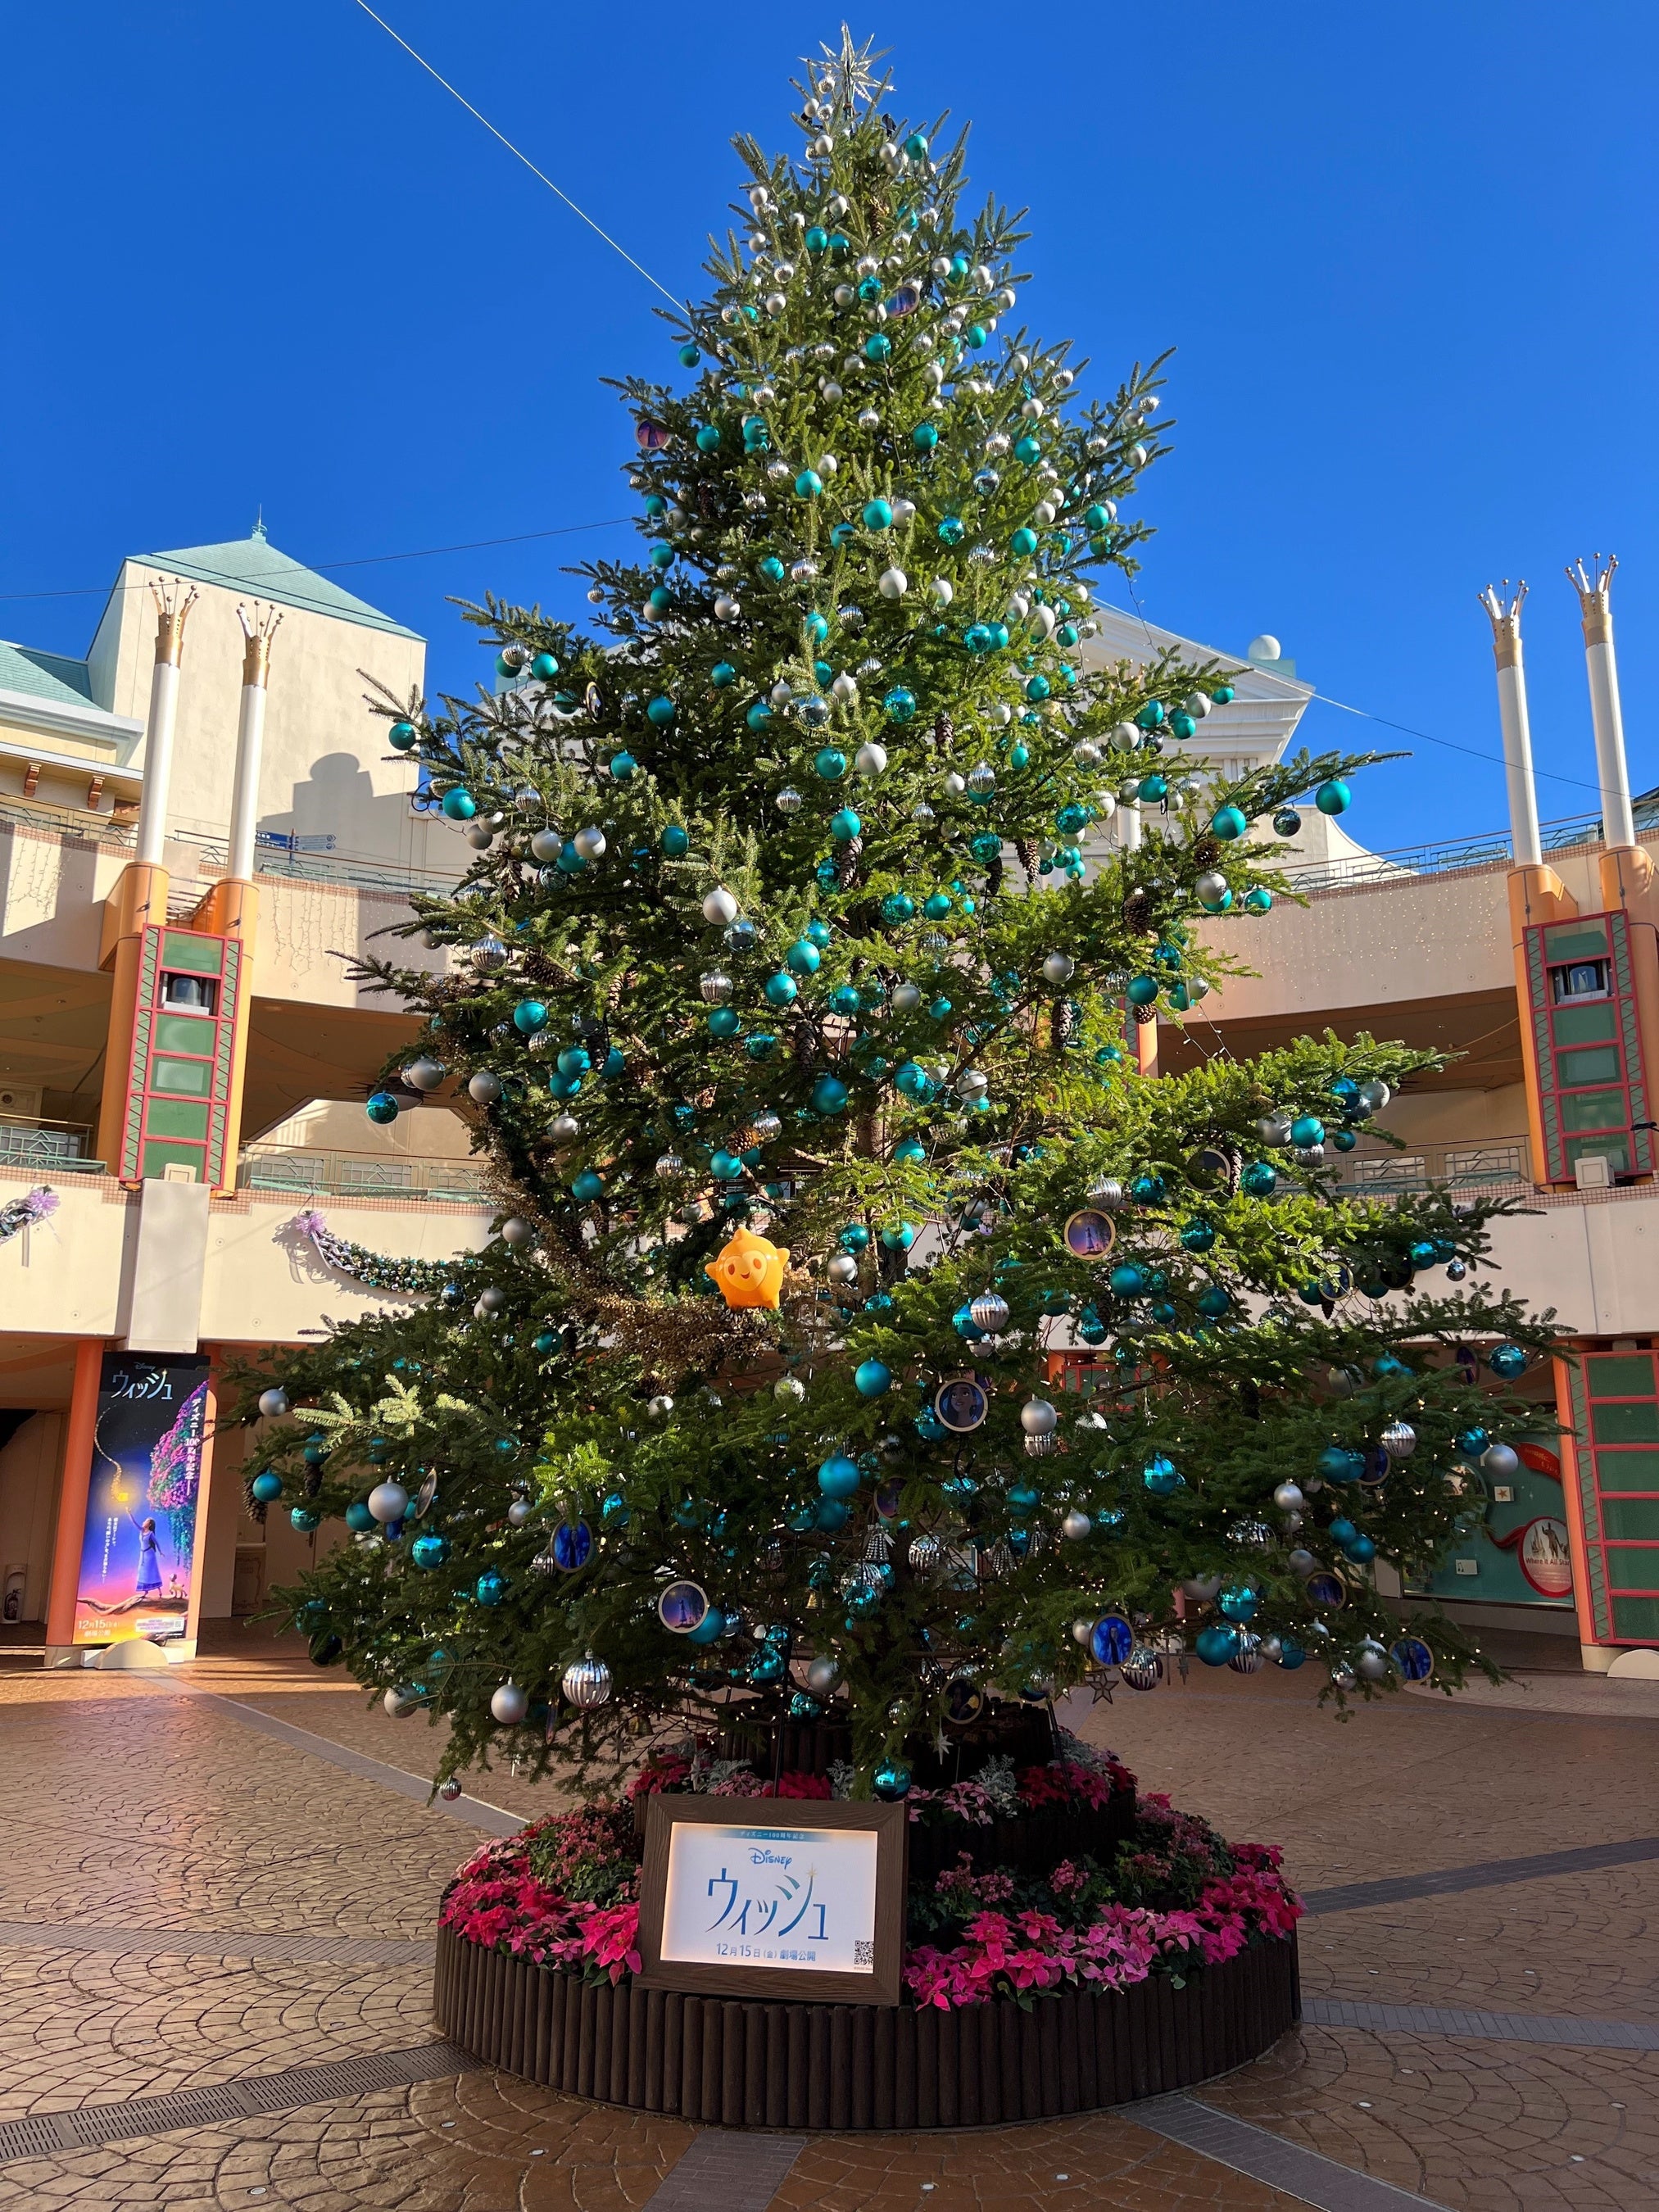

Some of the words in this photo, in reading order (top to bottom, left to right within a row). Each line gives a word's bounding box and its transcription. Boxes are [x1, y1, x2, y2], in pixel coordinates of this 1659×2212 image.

[111, 1369, 173, 1400] ウィッシュ
[740, 1830, 805, 1840] ディズニー100周年記念
[748, 1847, 792, 1870] Disney
[705, 1865, 829, 1940] ウィッシュ
